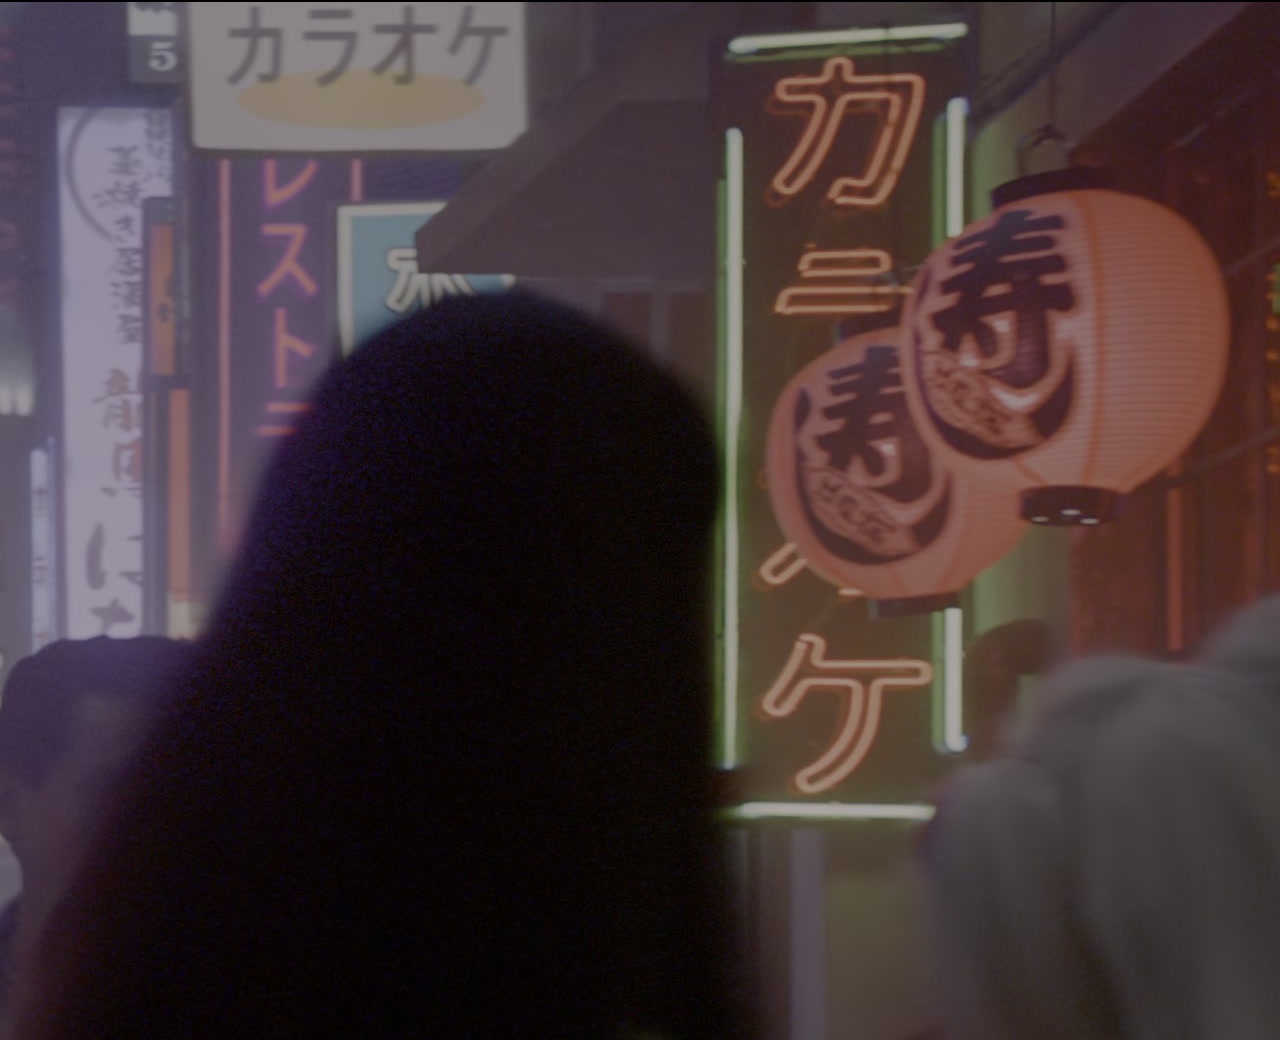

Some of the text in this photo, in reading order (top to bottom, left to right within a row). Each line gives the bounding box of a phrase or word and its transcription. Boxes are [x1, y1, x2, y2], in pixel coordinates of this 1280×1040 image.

[148, 41, 178, 72] 5
[227, 4, 509, 87] カラオケ
[758, 56, 933, 794] カラケ
